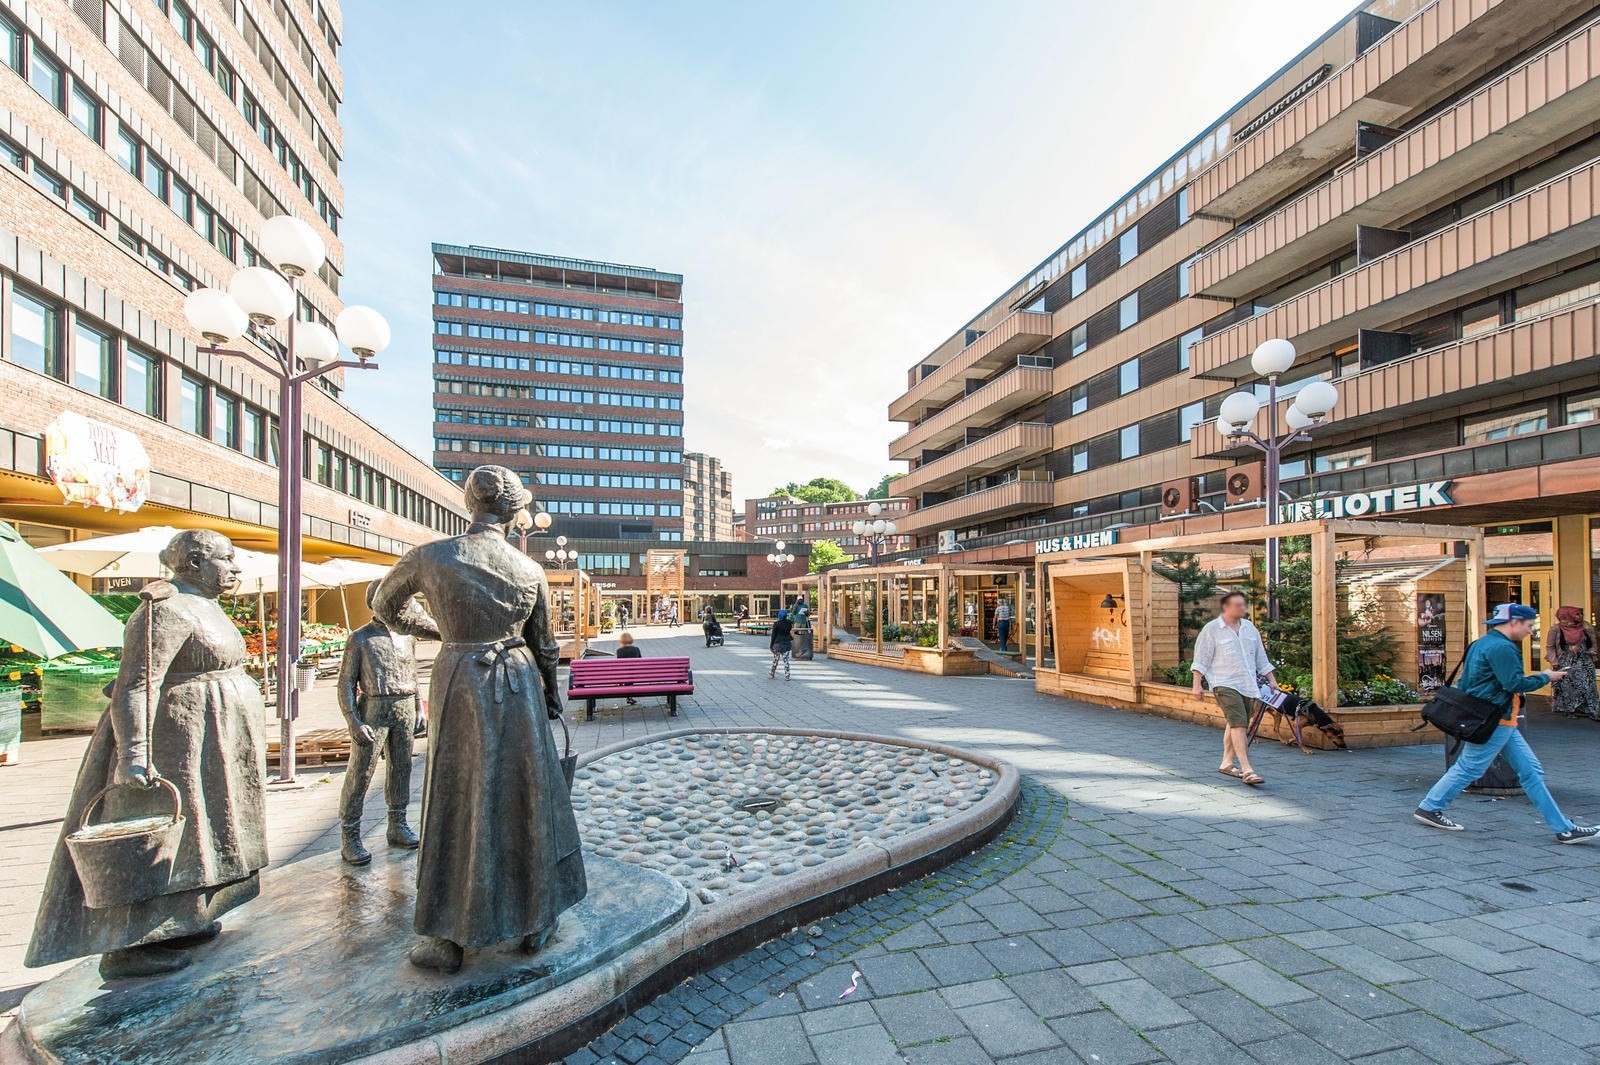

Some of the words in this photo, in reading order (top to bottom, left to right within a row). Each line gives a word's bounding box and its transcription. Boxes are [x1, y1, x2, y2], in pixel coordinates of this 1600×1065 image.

[92, 440, 117, 467] MAT
[1035, 538, 1061, 554] HUS
[1073, 530, 1113, 549] HJEM
